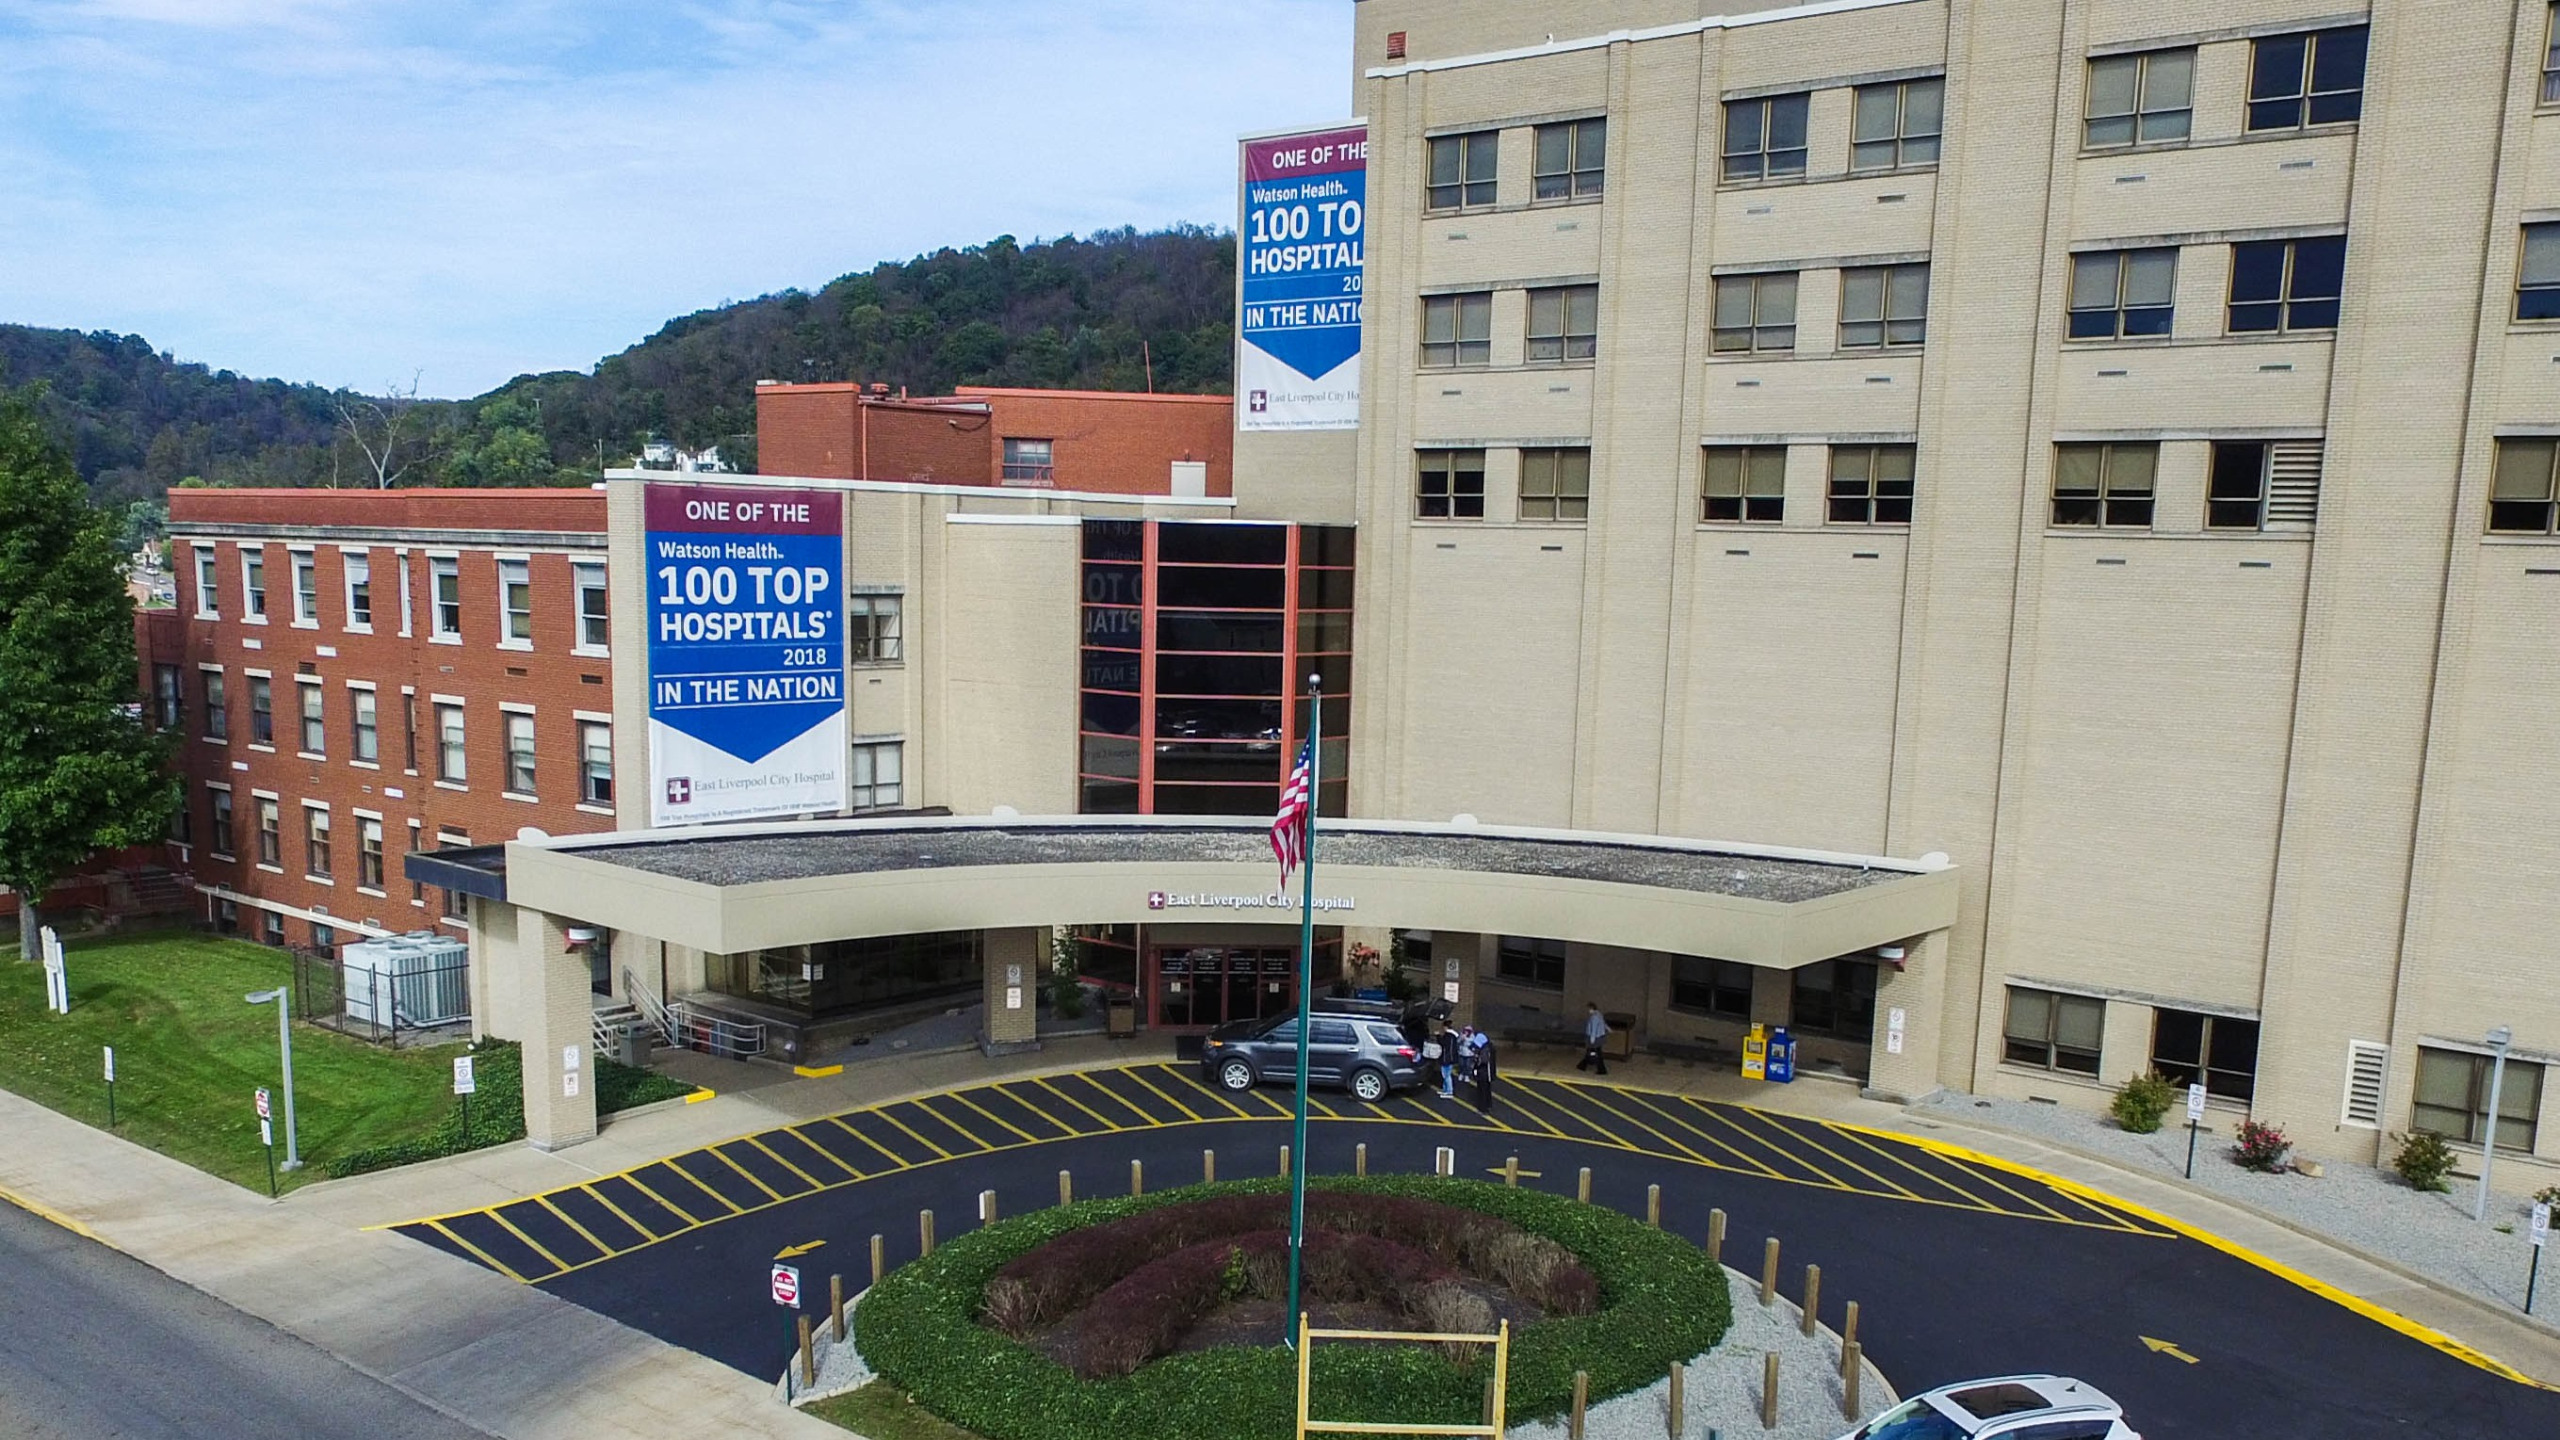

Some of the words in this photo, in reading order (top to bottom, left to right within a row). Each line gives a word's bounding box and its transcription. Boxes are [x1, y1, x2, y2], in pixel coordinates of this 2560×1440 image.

[1272, 149, 1306, 169] ONE
[1311, 146, 1333, 164] OF
[1338, 141, 1368, 161] THE
[1252, 188, 1297, 204] Watson
[1252, 205, 1309, 243] 100
[1318, 200, 1361, 237] TO
[1251, 241, 1364, 274] HOSPITAL
[1343, 275, 1361, 292] 20
[1246, 307, 1264, 328] IN
[1270, 305, 1307, 326] THE
[1313, 302, 1362, 324] NATI
[1287, 392, 1326, 404] Liverpool
[1328, 392, 1344, 402] City
[686, 501, 730, 521] ONE
[736, 503, 764, 521] OF
[769, 504, 810, 522] THE
[658, 541, 721, 558] Watson
[658, 566, 737, 605] 100
[747, 566, 829, 605] TOP
[783, 648, 827, 666] 2018
[657, 682, 681, 705] IN
[690, 679, 739, 703] THE
[747, 676, 836, 700] NATION
[694, 780, 716, 792] East
[718, 776, 768, 792] Liverpool
[769, 773, 792, 788] City
[794, 770, 835, 785] Hospital
[1167, 893, 1196, 906] East
[1200, 893, 1263, 909] Liverpool
[1266, 893, 1295, 909] City
